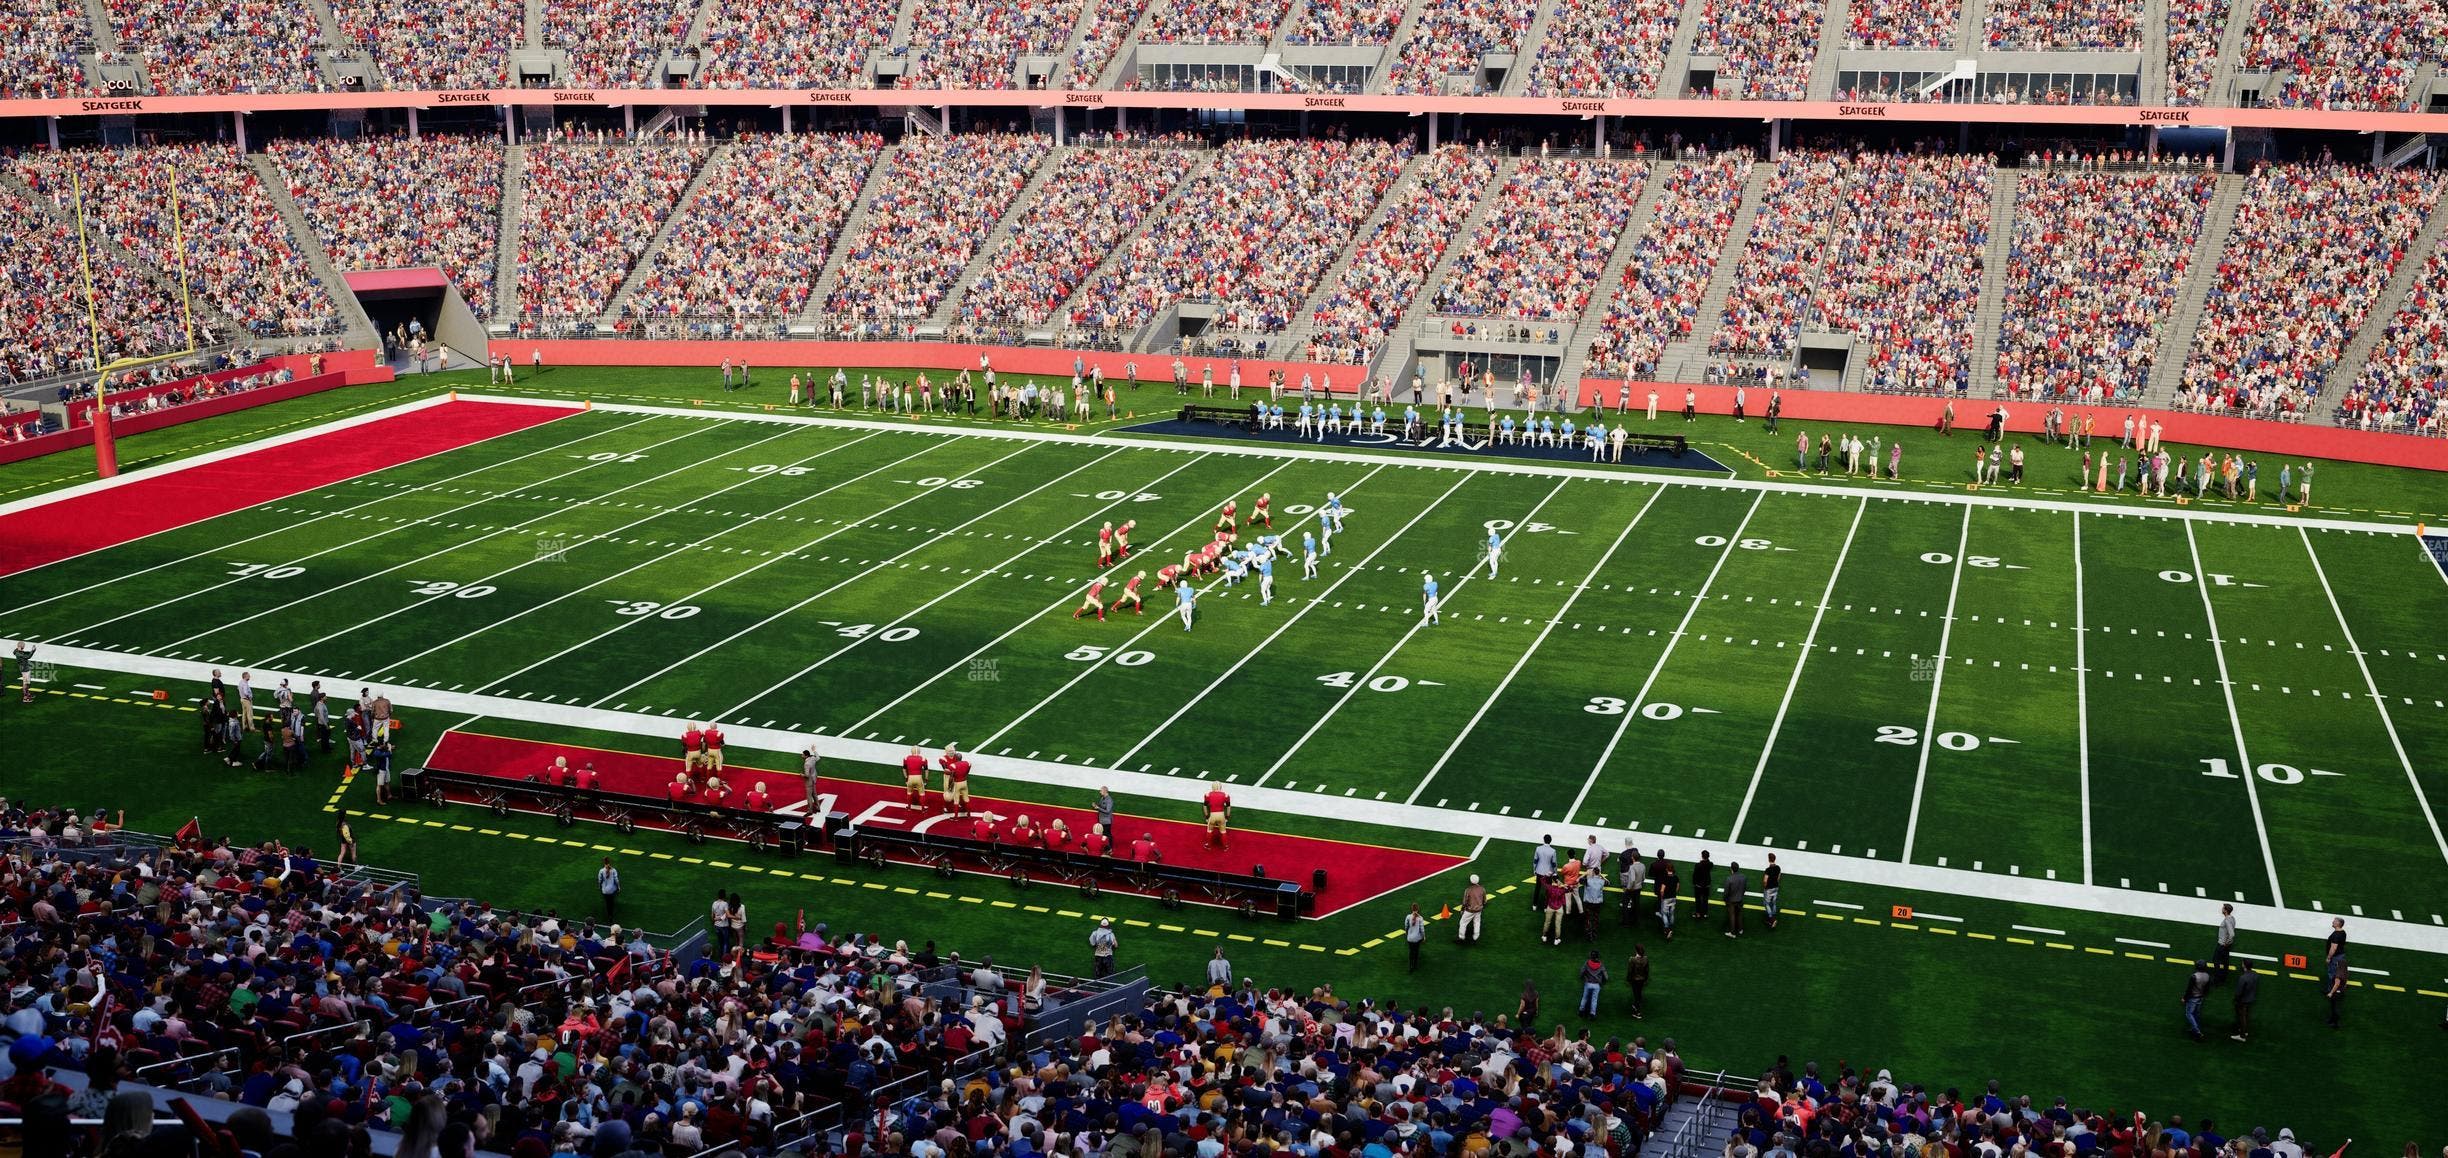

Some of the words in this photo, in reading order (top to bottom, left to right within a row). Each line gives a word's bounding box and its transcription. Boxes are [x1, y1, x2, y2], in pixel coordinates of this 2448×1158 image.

[1694, 535, 1772, 550] 30
[1919, 552, 2001, 568] 20
[228, 563, 307, 579] 10
[2158, 570, 2237, 586] 10
[410, 581, 498, 599] 20
[616, 601, 702, 620] 30
[836, 623, 921, 642] 40
[1063, 644, 1156, 666] 50
[1315, 671, 1410, 693] 40
[1583, 696, 1684, 721] 30
[1873, 725, 1981, 752] 20
[2200, 758, 2305, 785] 10
[1897, 907, 1907, 917] 20
[2291, 957, 2301, 967] 10
